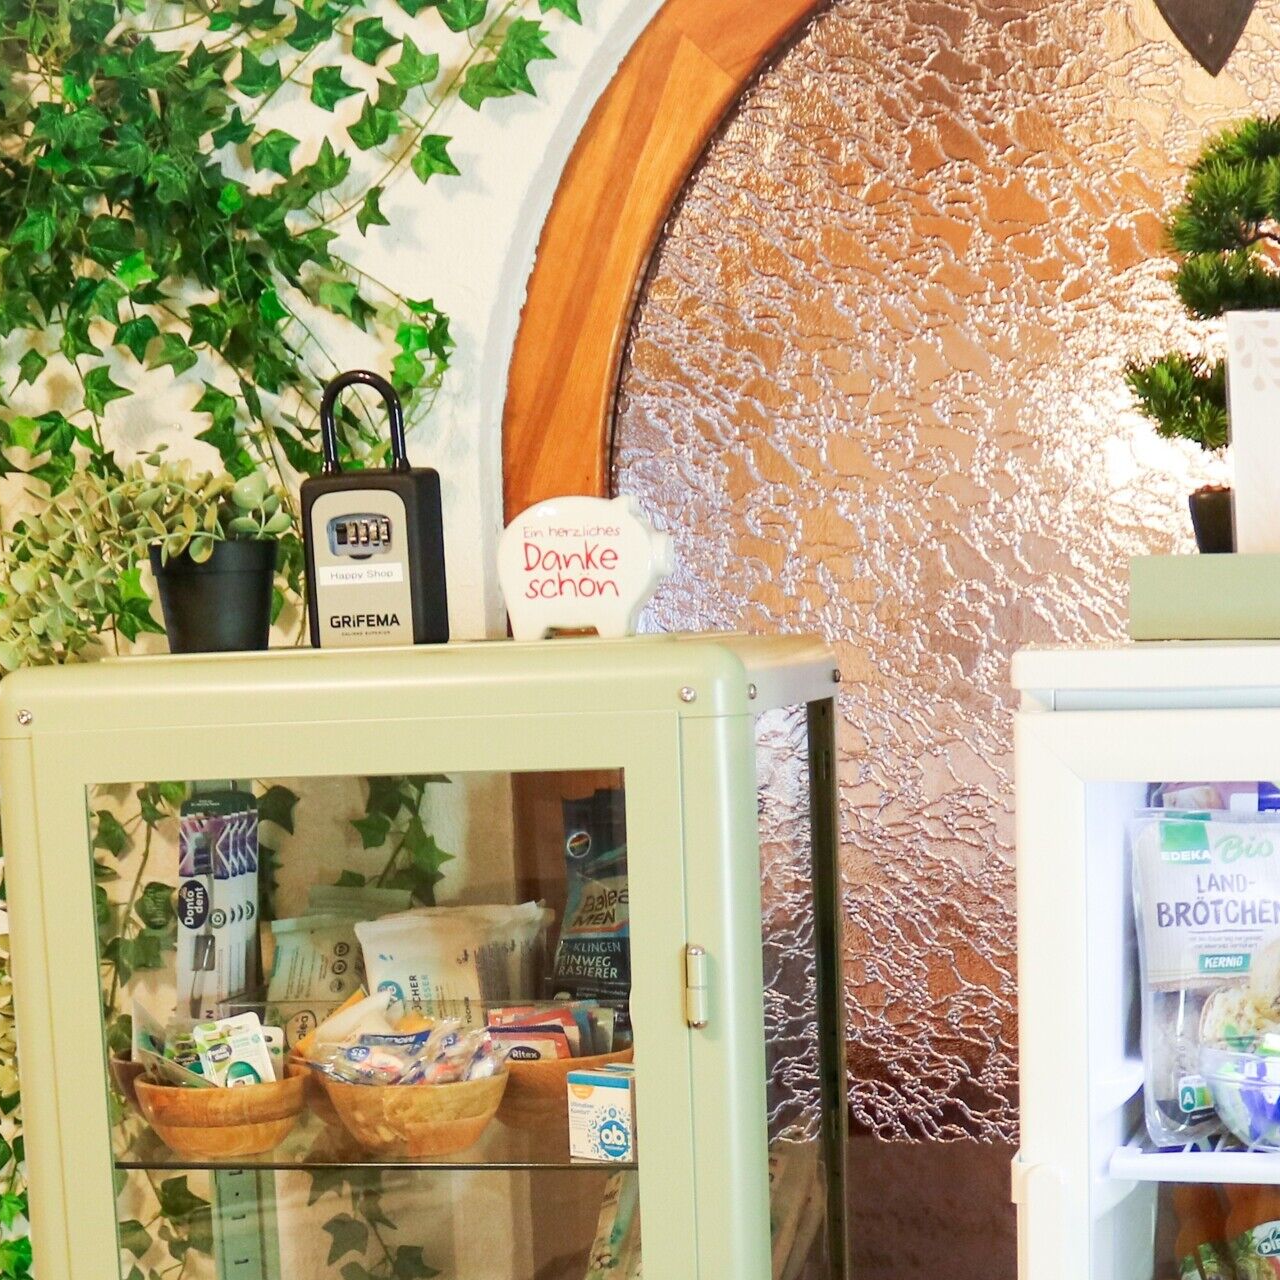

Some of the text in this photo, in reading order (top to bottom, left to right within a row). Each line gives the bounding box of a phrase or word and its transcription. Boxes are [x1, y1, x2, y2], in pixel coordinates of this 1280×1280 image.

[523, 525, 621, 539] Ein herzliches
[524, 540, 619, 571] Danke
[330, 569, 394, 581] Happy Shop
[525, 571, 620, 599] schön
[1160, 834, 1275, 864] EDEKA Bio
[1197, 873, 1256, 894] LAND-
[184, 890, 195, 926] Donto
[194, 887, 204, 914] dent
[572, 909, 616, 927] MEN
[1203, 955, 1244, 969] KERNIG
[558, 966, 618, 979] RASIERER
[511, 1049, 538, 1059] Ritex
